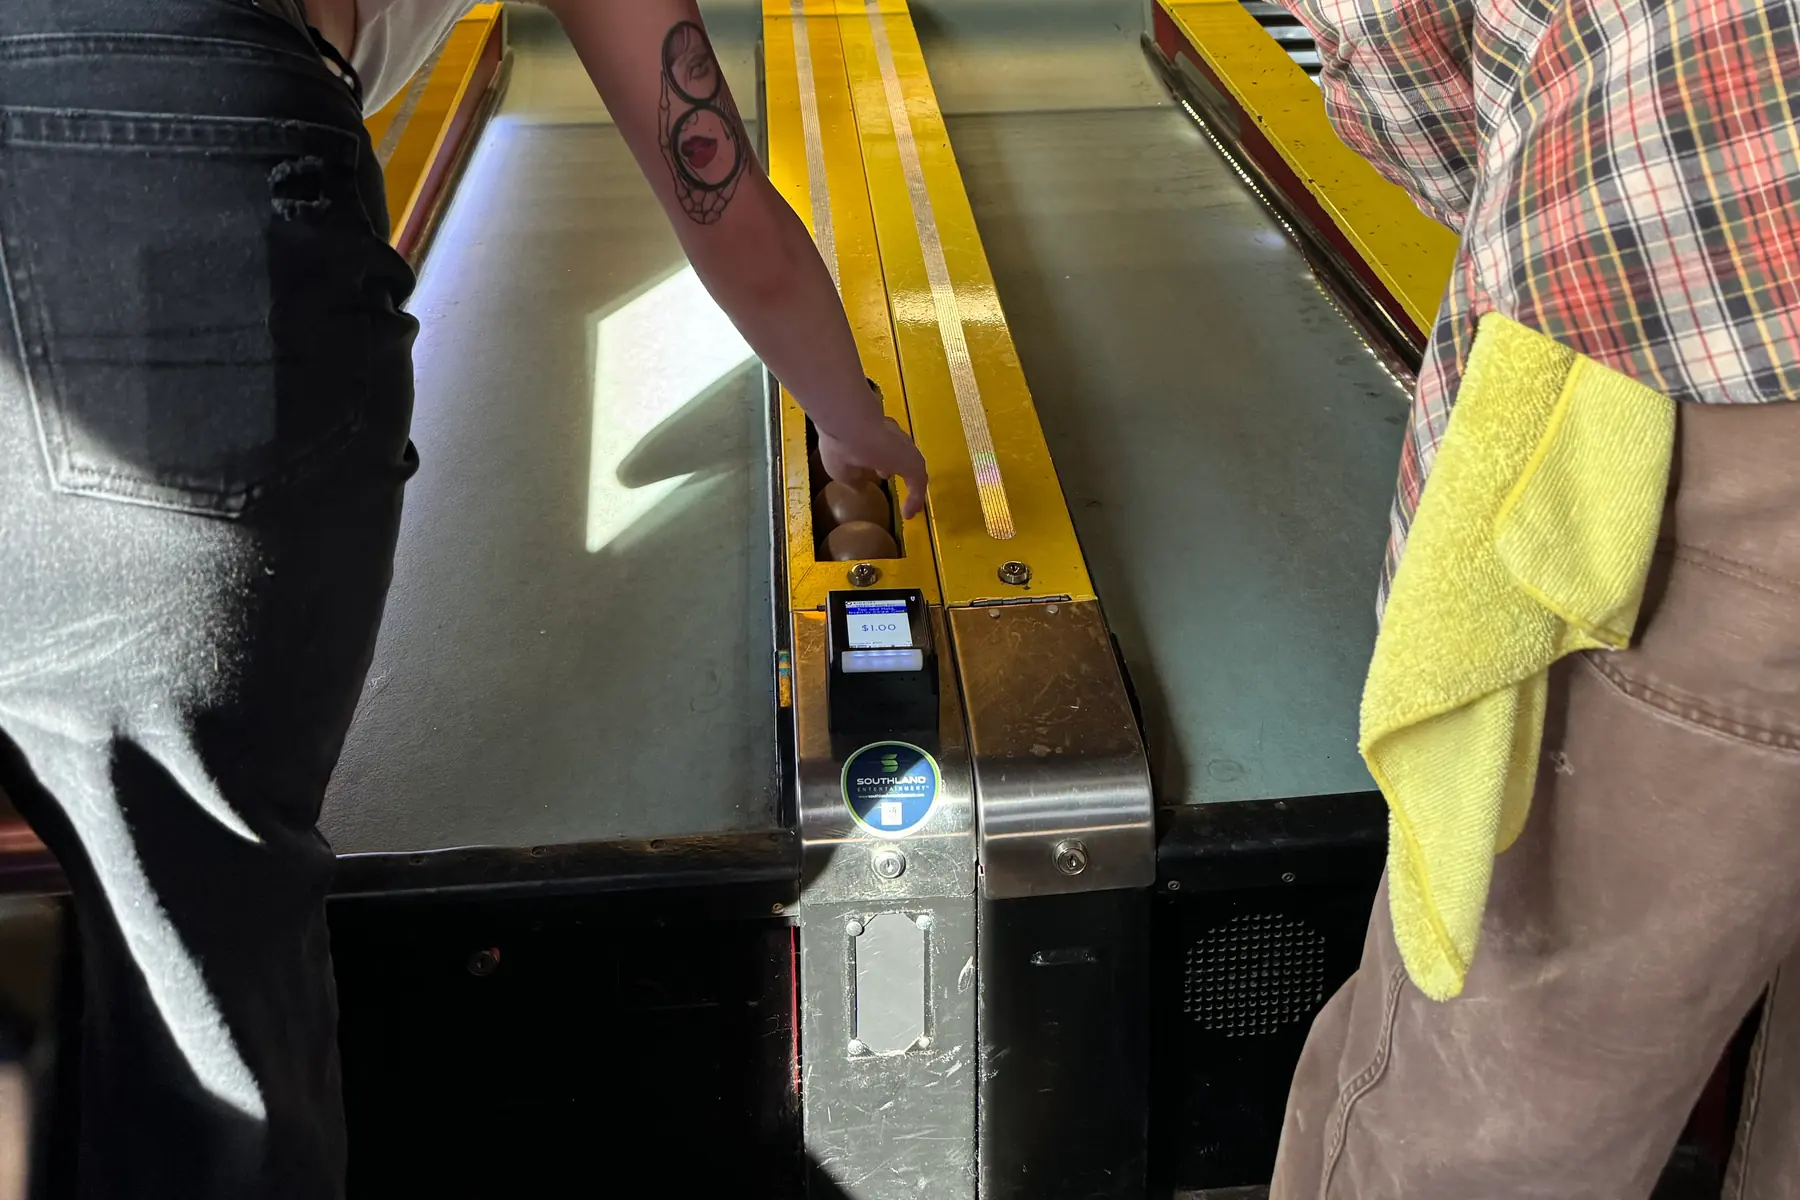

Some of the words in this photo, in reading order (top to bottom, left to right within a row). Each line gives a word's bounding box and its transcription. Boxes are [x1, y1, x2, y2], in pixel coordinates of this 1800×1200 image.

[861, 623, 897, 632] $1.00
[856, 775, 928, 786] SOUTHLAND
[857, 785, 926, 793] ENTERTAINMENT
